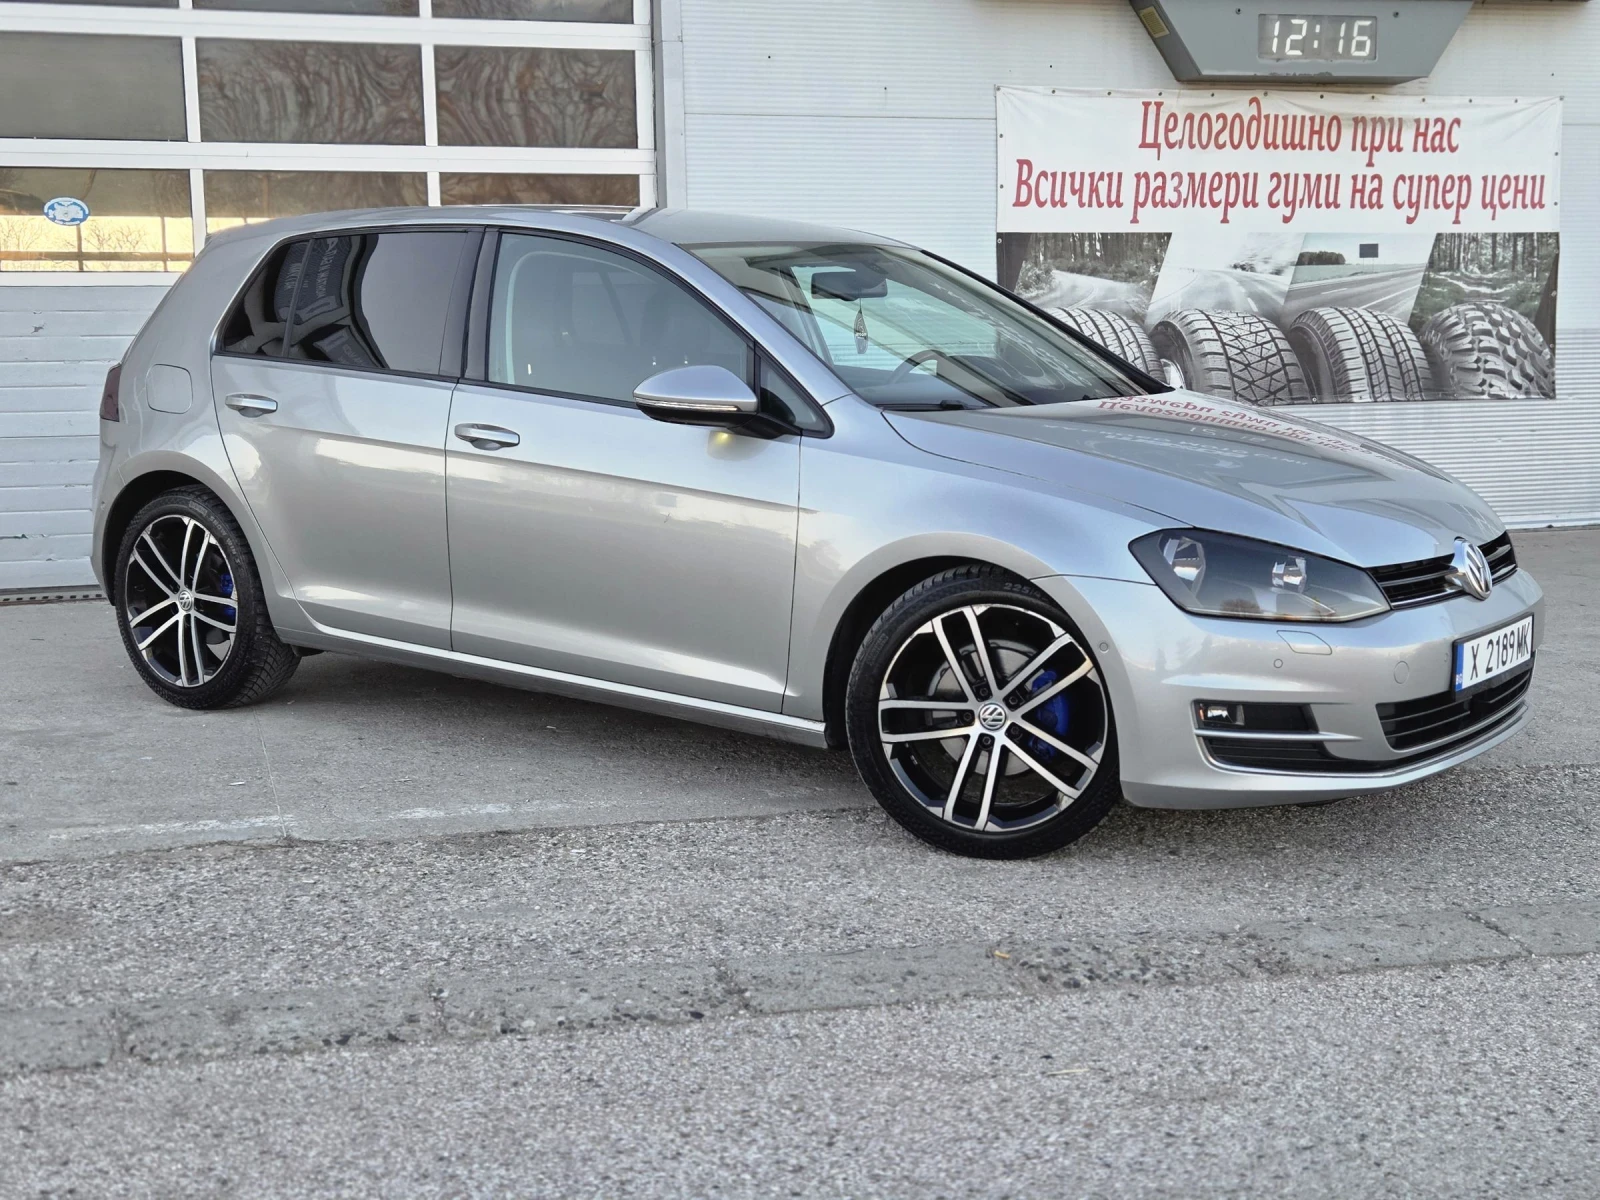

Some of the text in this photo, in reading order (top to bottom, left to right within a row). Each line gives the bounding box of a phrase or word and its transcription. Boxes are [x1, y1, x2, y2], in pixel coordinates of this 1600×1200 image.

[1272, 19, 1371, 56] 12:16
[1139, 97, 1461, 167] Целогодишно при нас
[1012, 159, 1545, 224] Всички размери гуми на супер цени
[1470, 643, 1480, 681] X
